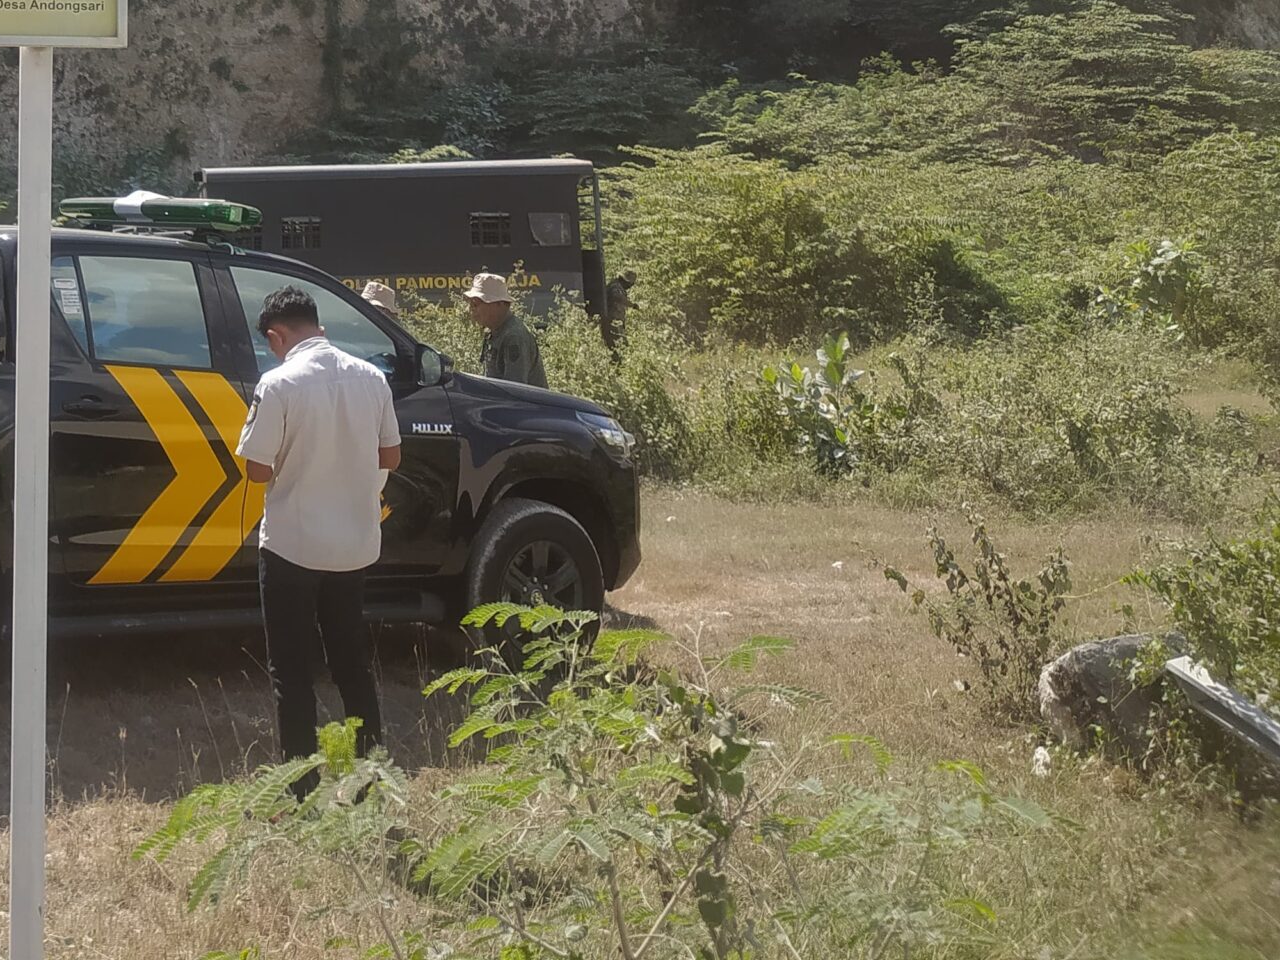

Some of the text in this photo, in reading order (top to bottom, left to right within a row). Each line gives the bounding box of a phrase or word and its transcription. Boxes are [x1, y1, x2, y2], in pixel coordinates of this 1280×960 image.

[29, 0, 105, 14] Andongsari
[396, 276, 473, 289] PAMONG
[506, 274, 541, 288] AJA
[412, 423, 453, 434] HILUX
